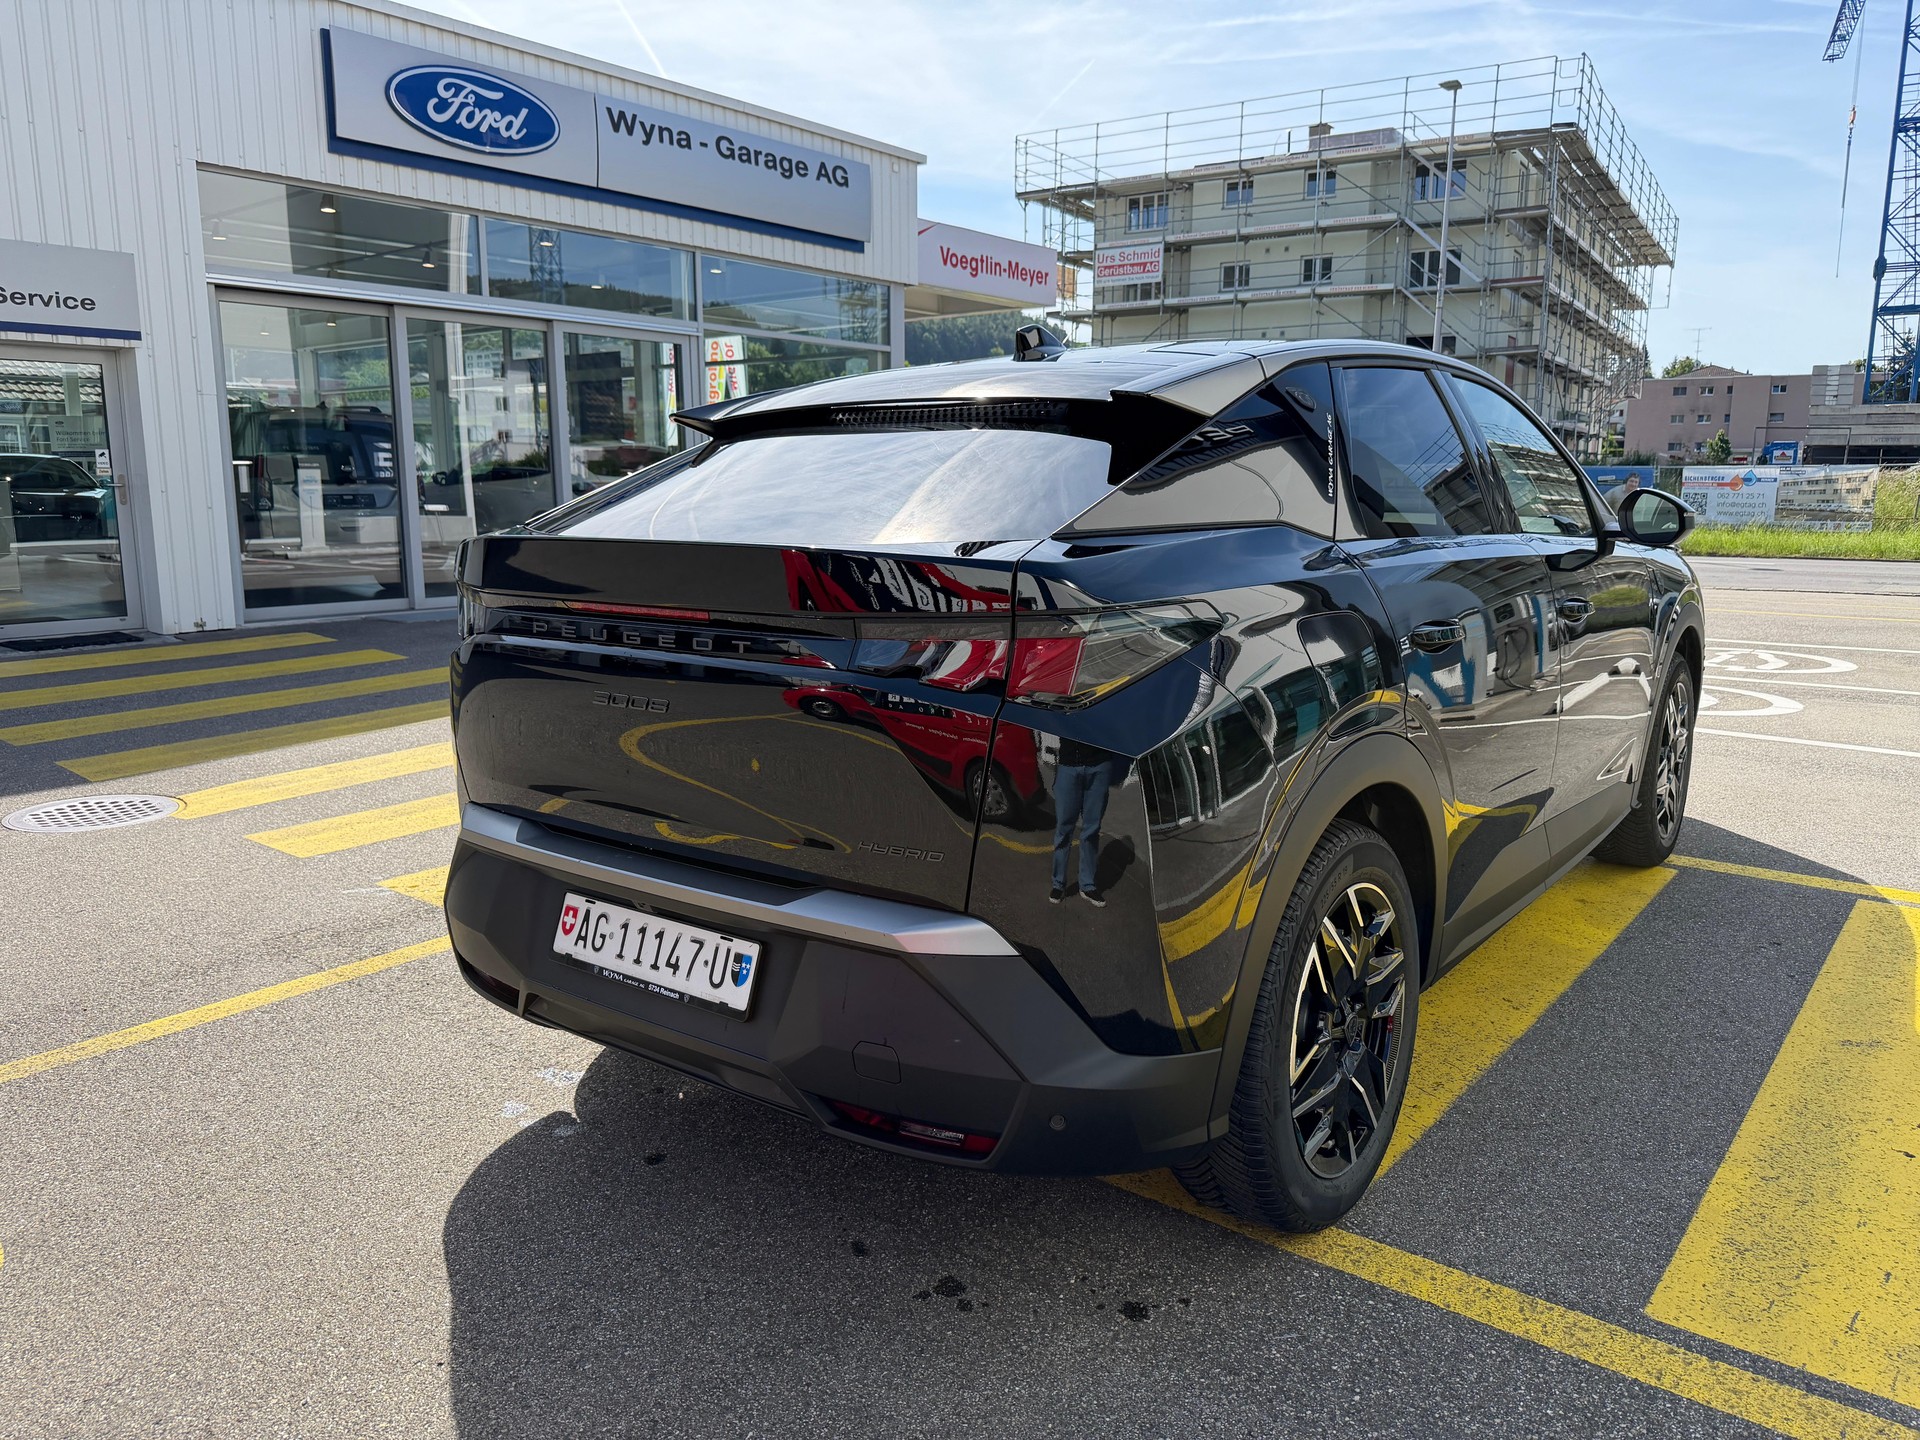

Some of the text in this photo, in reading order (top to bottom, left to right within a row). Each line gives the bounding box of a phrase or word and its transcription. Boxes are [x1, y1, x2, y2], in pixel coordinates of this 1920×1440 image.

[426, 77, 528, 141] Ford
[605, 106, 692, 150] Wyna
[715, 136, 809, 180] Garage
[816, 161, 850, 189] AG
[940, 245, 1049, 287] Voegtlin-Meyer
[1097, 248, 1161, 264] Urs Schmid
[1097, 262, 1159, 277] Gerüstbau AG
[0, 286, 97, 312] Service
[1326, 412, 1333, 427] AG
[1717, 501, 1767, 510] info@egtag.ch
[533, 621, 752, 654] PEUGEOT
[593, 690, 671, 713] 3008
[858, 841, 945, 862] HYBRID
[574, 907, 732, 989] AG 11147 U
[602, 969, 623, 982] WYNA
[648, 983, 660, 993] 5734
[660, 987, 680, 999] Reinach
